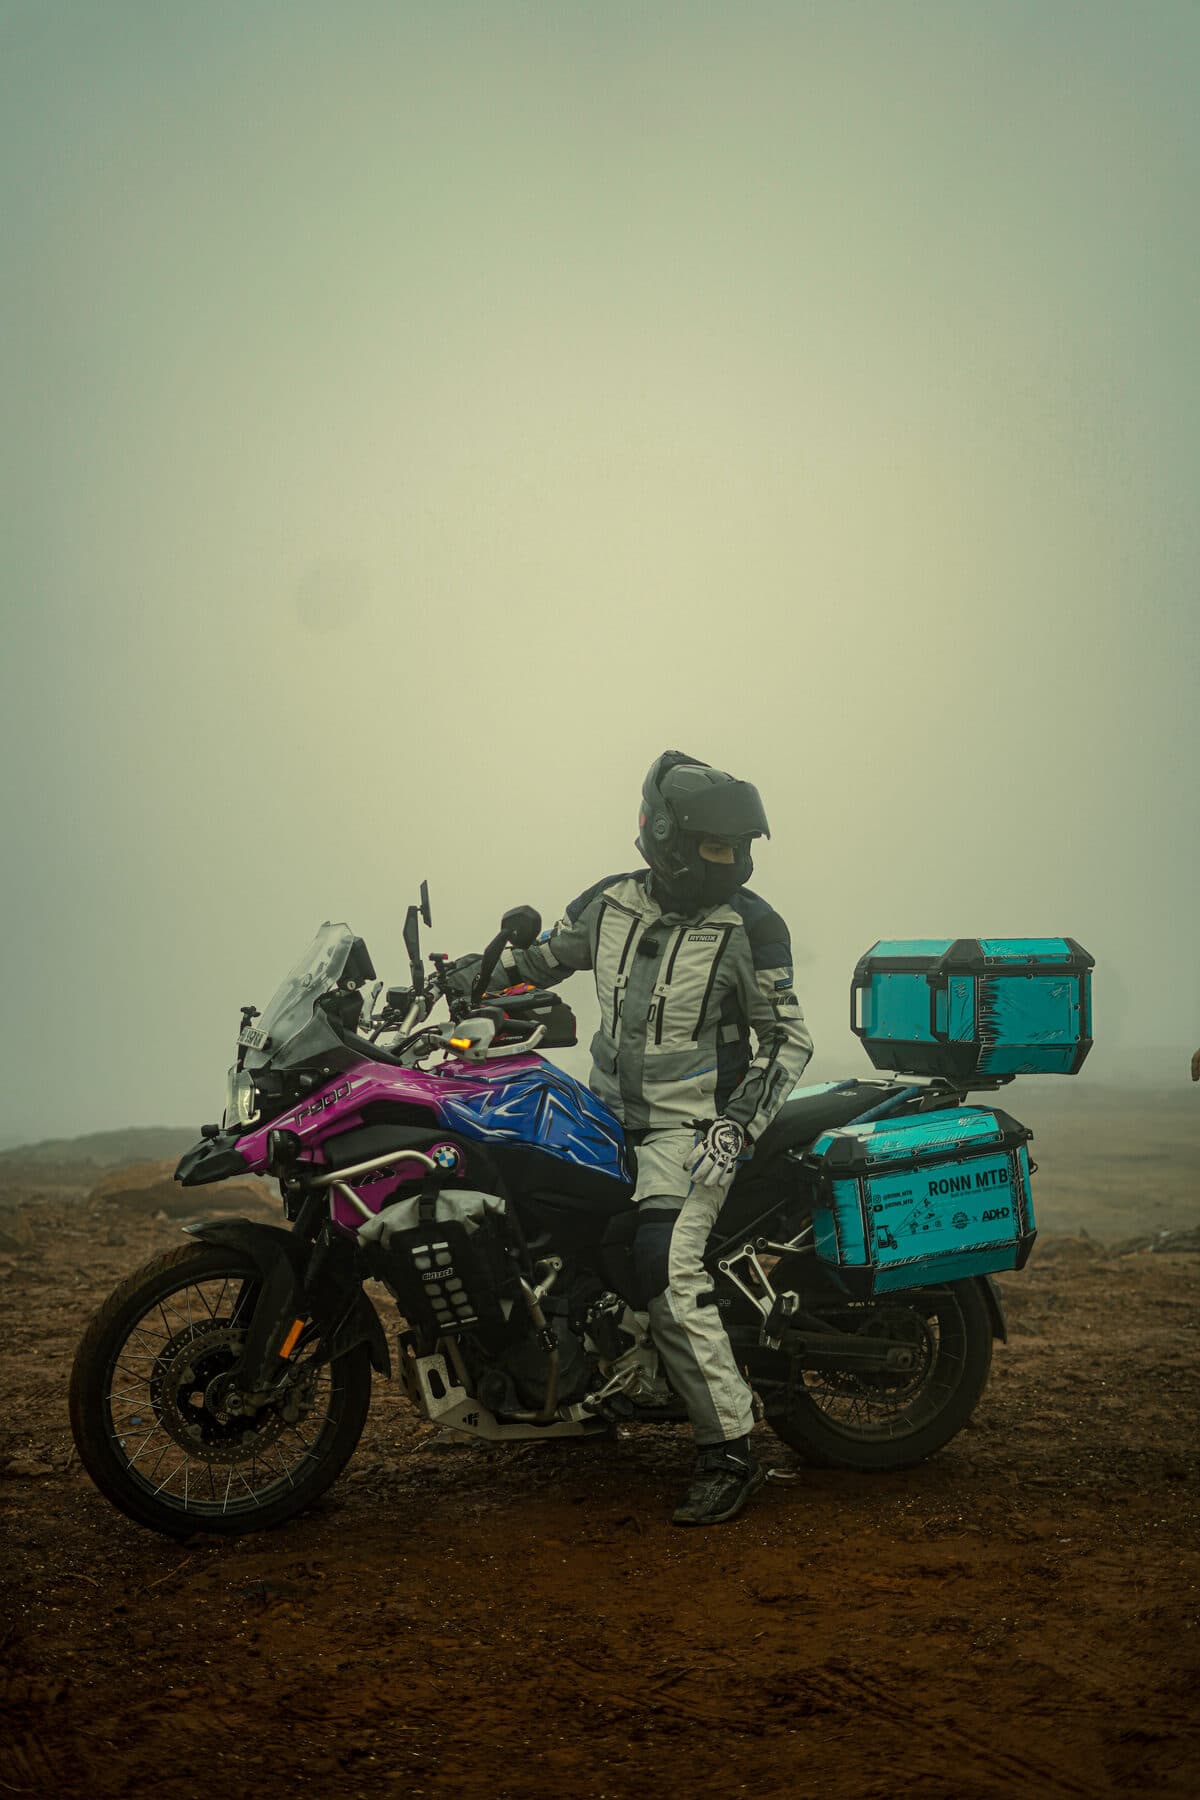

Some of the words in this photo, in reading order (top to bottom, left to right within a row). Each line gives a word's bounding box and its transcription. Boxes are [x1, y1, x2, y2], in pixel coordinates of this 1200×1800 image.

[688, 934, 717, 942] RYNOX
[928, 1175, 971, 1196] RONN
[976, 1168, 1008, 1187] MTB
[981, 1207, 1010, 1223] ADHD
